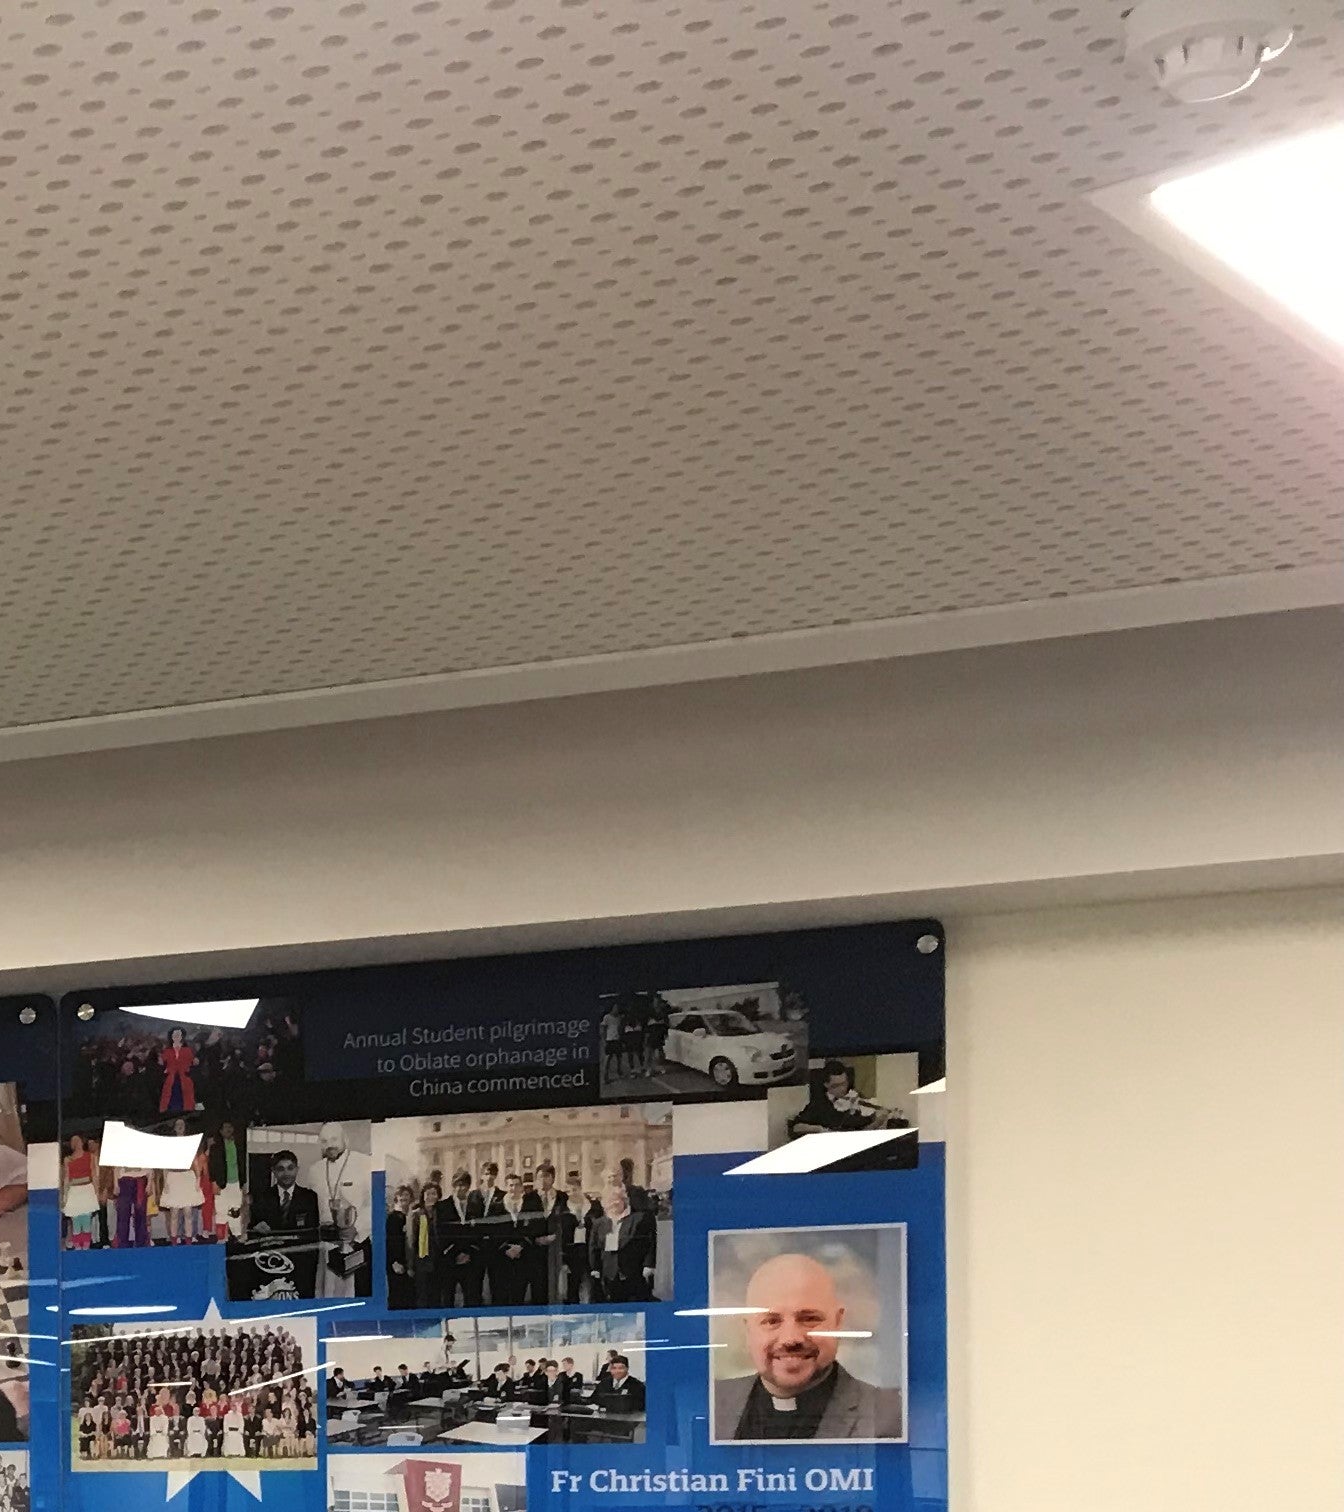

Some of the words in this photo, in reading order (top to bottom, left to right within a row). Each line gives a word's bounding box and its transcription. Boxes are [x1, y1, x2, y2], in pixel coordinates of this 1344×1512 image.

[343, 1028, 406, 1048] Annual
[412, 1025, 484, 1044] Student
[489, 1020, 590, 1042] pilgrimage
[377, 1059, 395, 1072] to
[399, 1053, 461, 1071] Oblate
[465, 1048, 567, 1069] orphanage
[572, 1042, 589, 1059] in
[409, 1078, 462, 1096] China
[467, 1070, 589, 1092] commenced.
[550, 1470, 582, 1492] Fr
[589, 1469, 729, 1492] Christian
[736, 1468, 797, 1491] Fini
[805, 1468, 873, 1491] OMI
